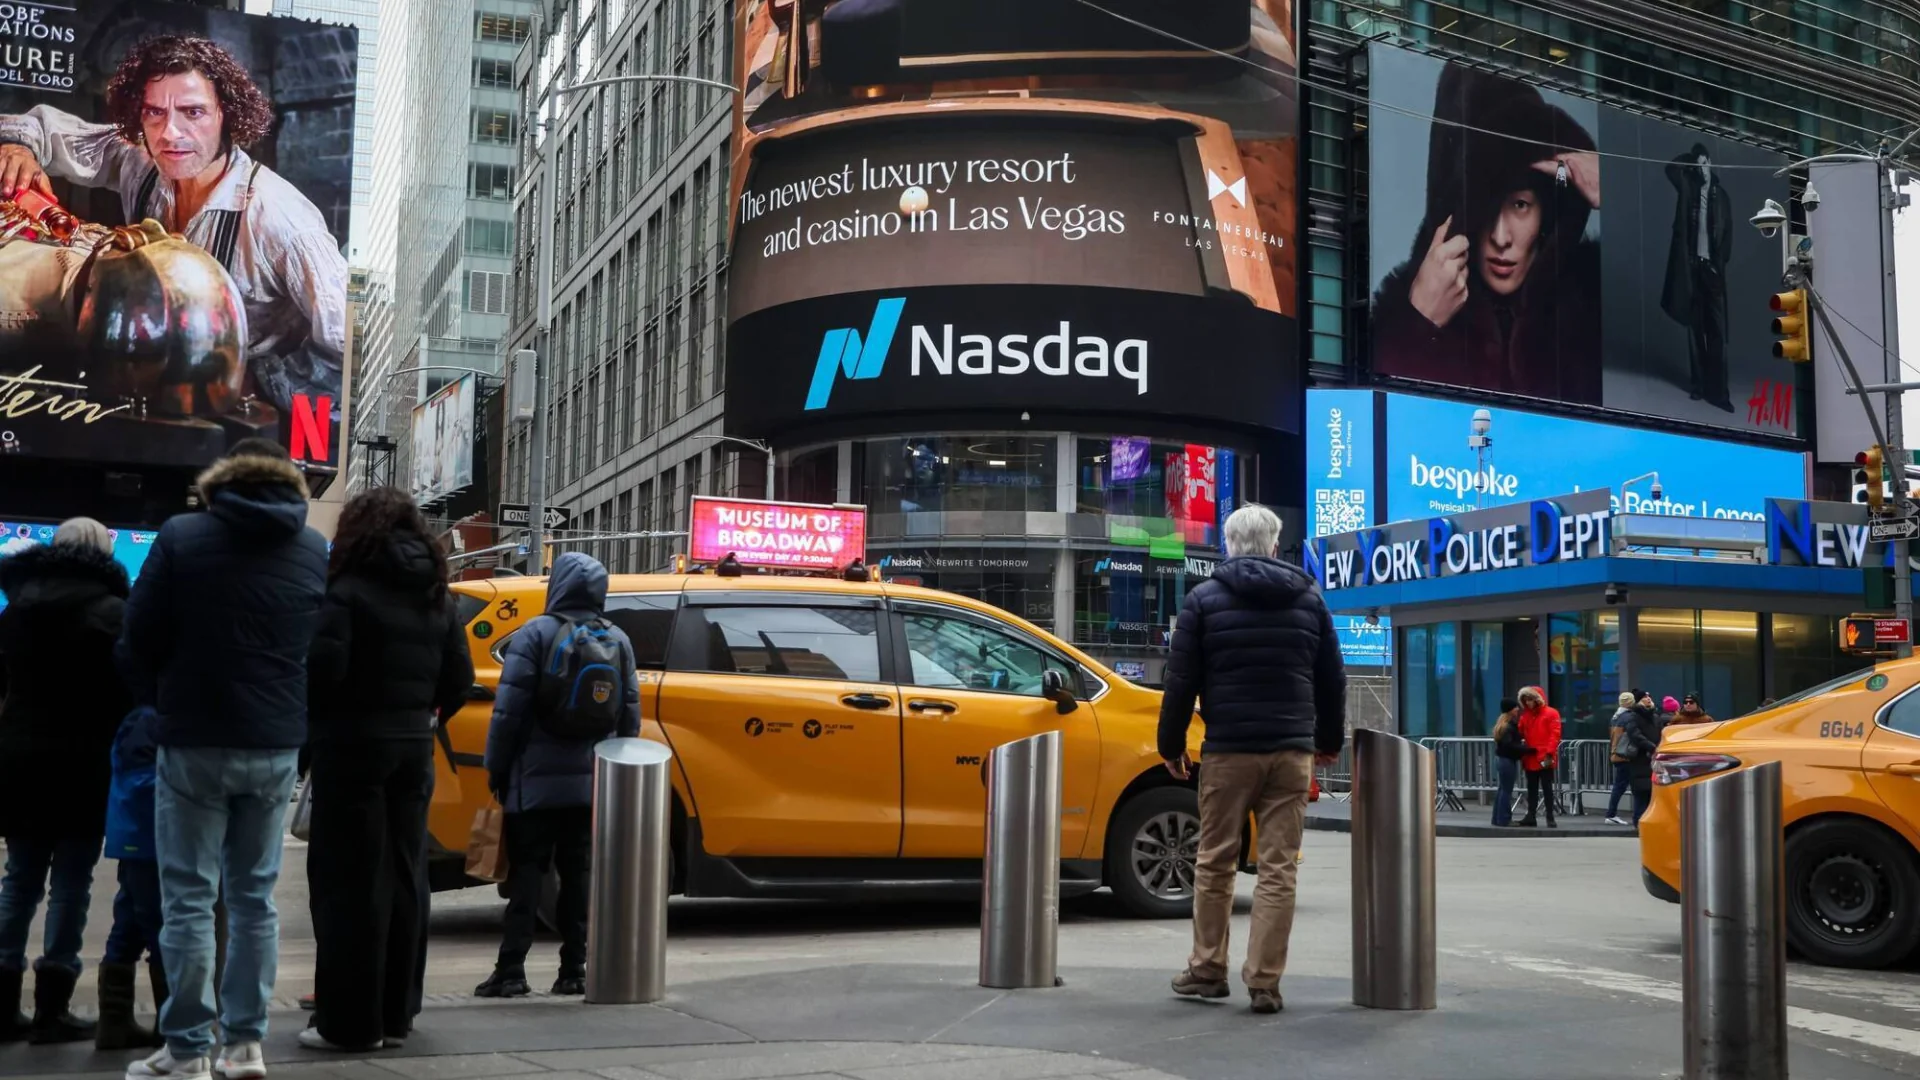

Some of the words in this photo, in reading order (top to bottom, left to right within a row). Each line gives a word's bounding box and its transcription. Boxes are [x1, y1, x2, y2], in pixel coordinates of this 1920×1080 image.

[0, 20, 75, 43] ATIONS
[0, 43, 65, 73] URE
[0, 68, 24, 82] DEL
[31, 72, 74, 87] TORO
[740, 190, 767, 224] The
[769, 164, 855, 211] newest
[862, 158, 957, 193] luxury
[967, 152, 1076, 184] resort
[763, 216, 801, 258] and
[806, 209, 901, 245] casino
[910, 204, 938, 233] in
[949, 197, 1009, 231] Las
[1018, 196, 1126, 240] Vegas
[1153, 211, 1284, 248] FONTAINEBLEAU
[1185, 237, 1212, 250] LAS
[1222, 243, 1264, 262] VEGAS
[911, 320, 1148, 395] Nasdaq
[1747, 379, 1793, 430] H&M
[290, 393, 332, 461] N
[1327, 407, 1345, 479] bespoke
[1411, 454, 1518, 500] bespoke
[544, 514, 560, 523] AY
[1429, 499, 1465, 513] Physical
[1624, 491, 1695, 518] Better
[717, 508, 808, 530] MUSEUM
[813, 514, 842, 532] OF
[1765, 498, 1870, 567] NEW
[1874, 525, 1888, 535] ONE
[1896, 523, 1911, 534] WAY
[1303, 538, 1355, 590] NEW
[1356, 528, 1422, 586] YORK
[1428, 518, 1518, 577] POLICE
[1530, 500, 1610, 565] DEPT
[891, 558, 922, 568] Nasdaq
[936, 559, 974, 567] REWRITE
[978, 559, 1029, 567] TOMORROW
[1110, 561, 1142, 573] Nasdaq
[956, 755, 981, 765] NYC
